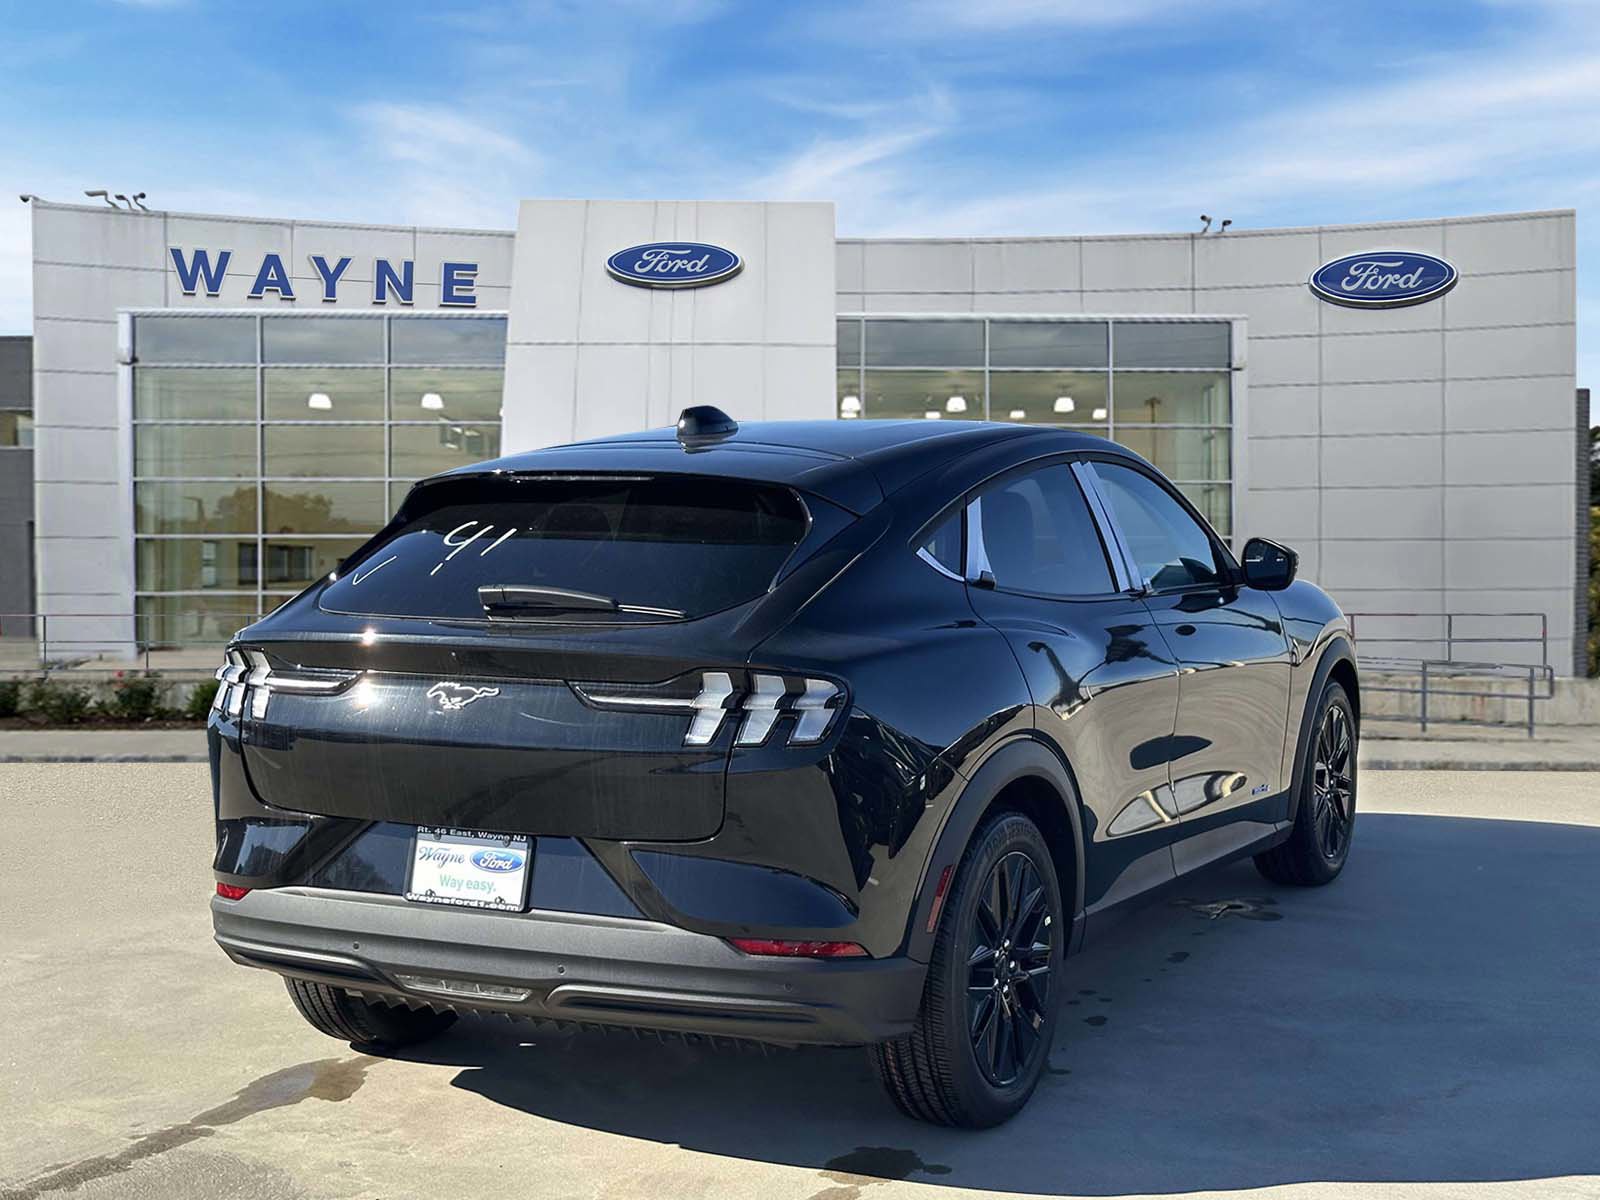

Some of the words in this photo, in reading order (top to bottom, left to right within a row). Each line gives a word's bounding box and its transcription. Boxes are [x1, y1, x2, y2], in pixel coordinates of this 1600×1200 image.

[633, 249, 710, 273] Ford
[169, 247, 479, 306] WAYNE
[1341, 261, 1425, 291] Ford
[434, 827, 447, 835] 46
[450, 828, 475, 838] East,
[478, 831, 510, 842] Wayne
[512, 834, 527, 842] NJ
[418, 846, 465, 869] Wayne
[480, 851, 513, 870] Ford
[439, 874, 463, 892] Way
[465, 879, 497, 894] easy.
